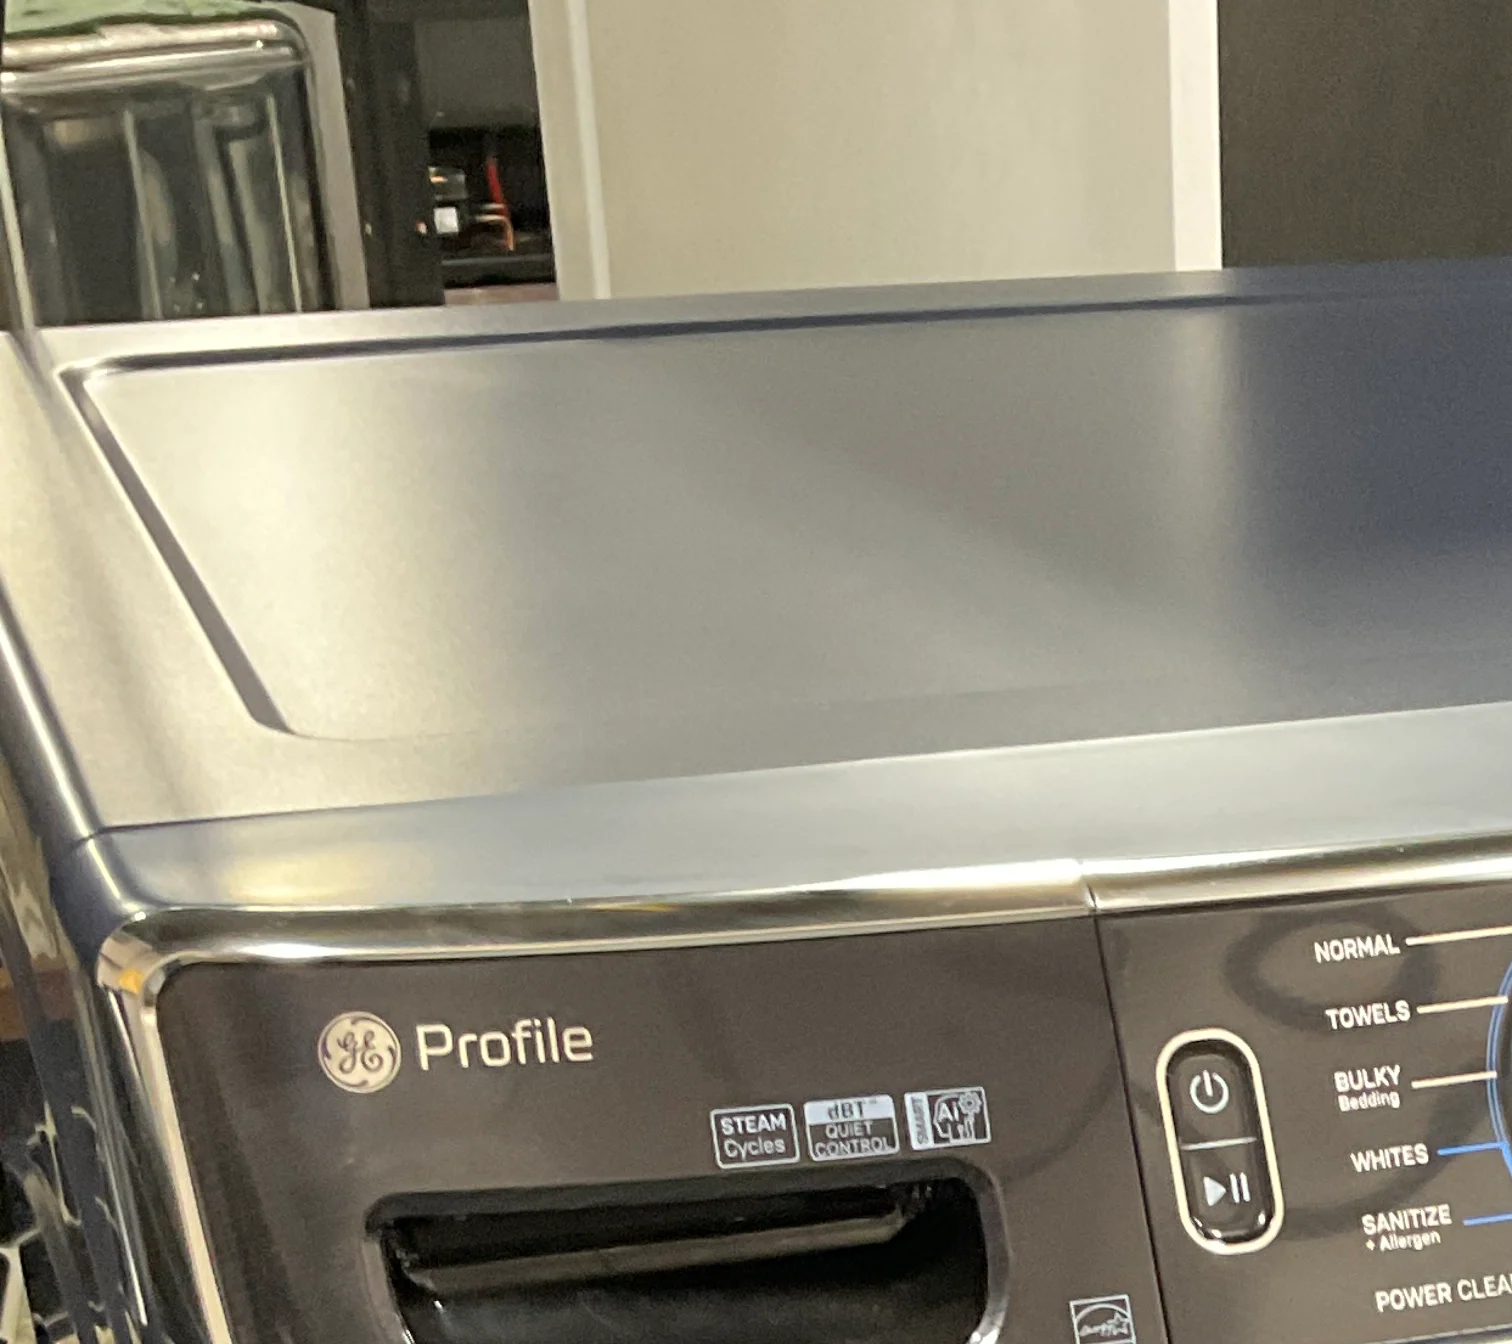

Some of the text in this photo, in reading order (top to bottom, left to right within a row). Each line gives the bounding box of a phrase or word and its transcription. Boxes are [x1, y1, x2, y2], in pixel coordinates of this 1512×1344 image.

[1313, 933, 1401, 963] NORMAL
[1325, 1000, 1411, 1030] TOWELS
[415, 1016, 594, 1071] Profile
[1334, 1064, 1401, 1093] BULKY
[1337, 1091, 1401, 1112] Bedding
[720, 1112, 788, 1136] STEAM
[825, 1119, 873, 1138] QUIET
[723, 1136, 786, 1162] Cycles
[815, 1136, 890, 1158] CONTROL
[1351, 1143, 1429, 1173] WHITES
[1361, 1203, 1453, 1236] SANITIZE
[1379, 1231, 1441, 1252] Allergen
[1375, 1282, 1453, 1313] POWER
